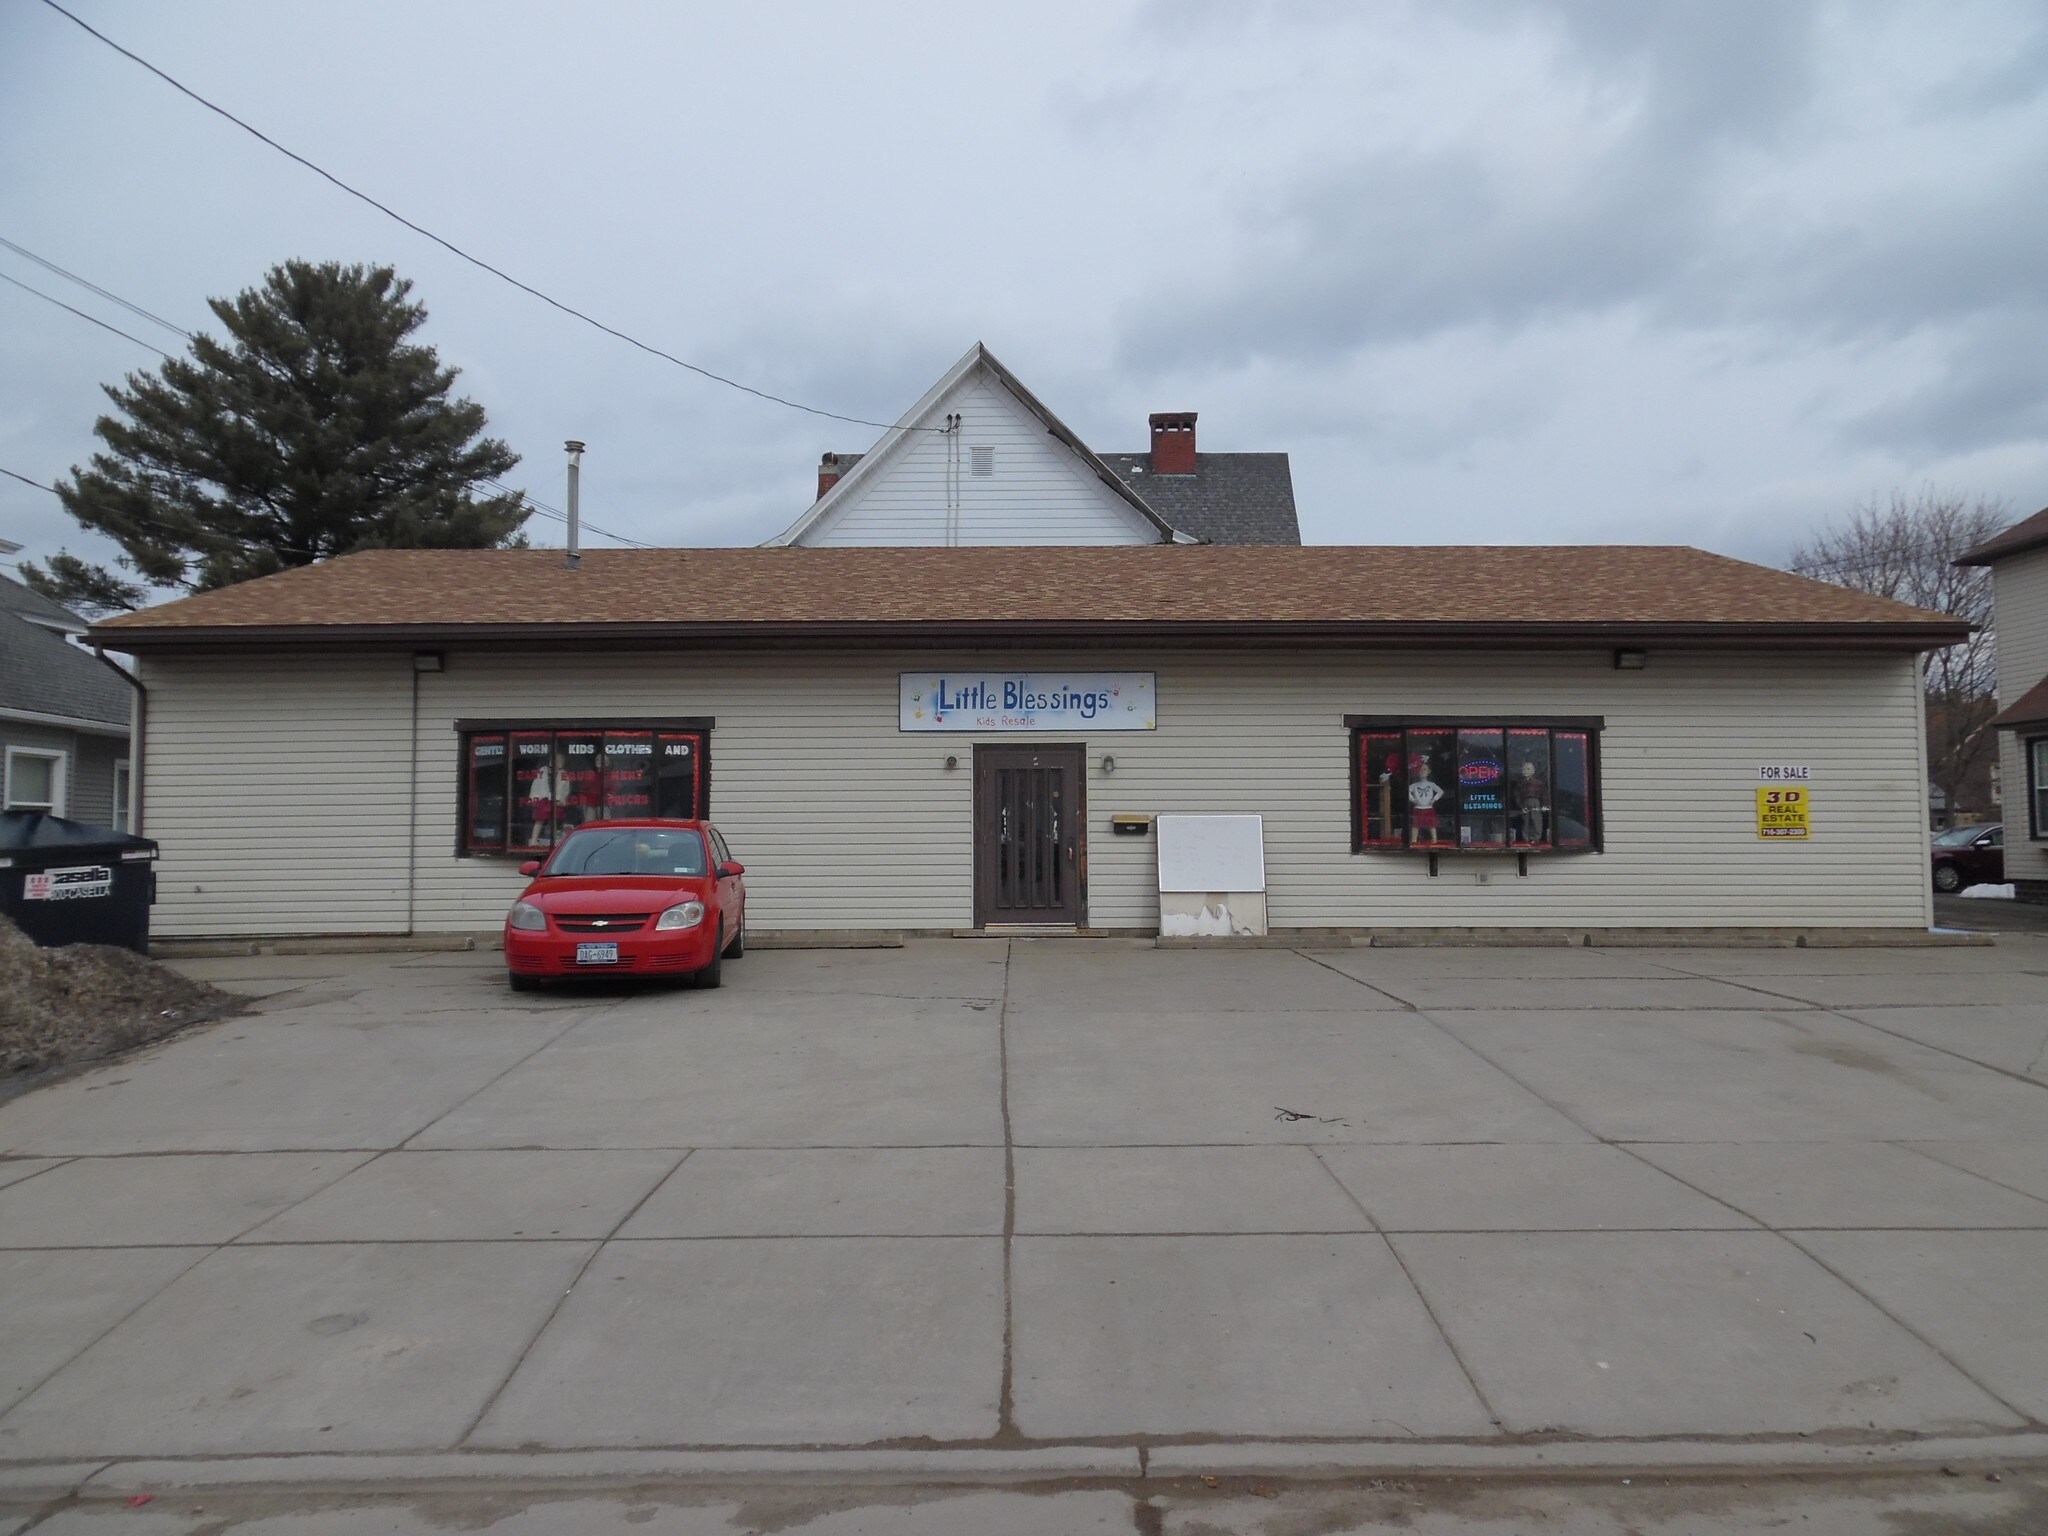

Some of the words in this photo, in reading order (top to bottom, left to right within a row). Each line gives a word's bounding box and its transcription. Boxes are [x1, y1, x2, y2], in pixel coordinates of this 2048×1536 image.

[939, 679, 997, 710] Little
[1003, 680, 1109, 719] Blessings
[976, 716, 996, 727] Kids
[1001, 715, 1036, 727] Resale
[519, 744, 548, 755] WORN
[568, 744, 594, 755] KIDS
[604, 744, 652, 755] CLOTHES
[664, 745, 689, 756] AND
[1458, 765, 1499, 780] OPEN
[1760, 767, 1780, 778] FOR
[1783, 767, 1808, 778] SALE
[1766, 791, 1781, 804] 3
[1785, 791, 1800, 802] D
[1769, 806, 1798, 814] REAL
[1762, 814, 1805, 822] ESTATE
